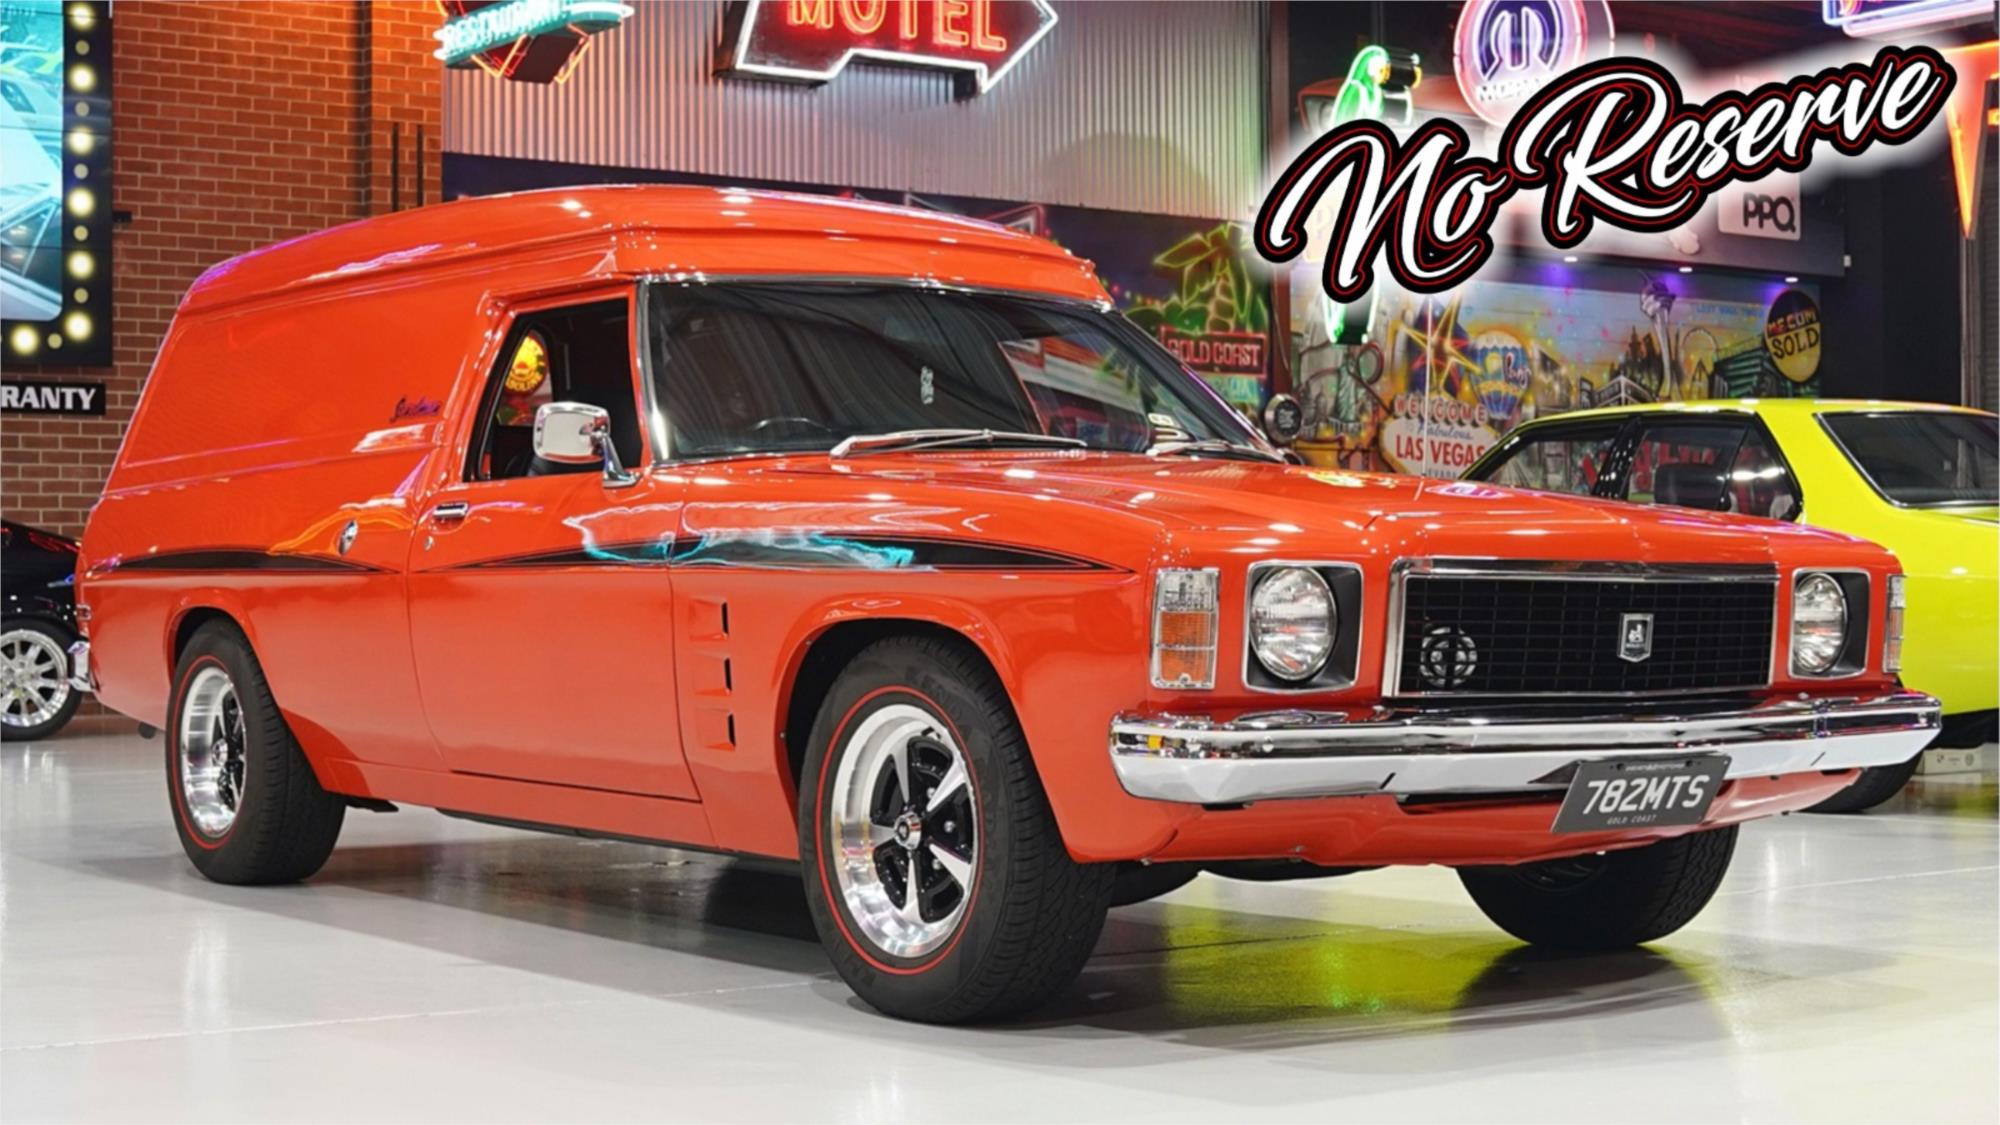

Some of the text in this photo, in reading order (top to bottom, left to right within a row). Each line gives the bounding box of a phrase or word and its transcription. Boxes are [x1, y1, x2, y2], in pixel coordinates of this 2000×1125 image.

[1743, 193, 1796, 233] PPQ
[1166, 338, 1261, 367] GOLD COAST
[1771, 327, 1819, 360] SOLD
[0, 385, 96, 410] RANTY
[1395, 398, 1486, 424] WECOME
[1396, 434, 1485, 467] LAS VEGAS
[1583, 775, 1710, 815] 782MTS
[1606, 813, 1657, 826] GOLD COAST
